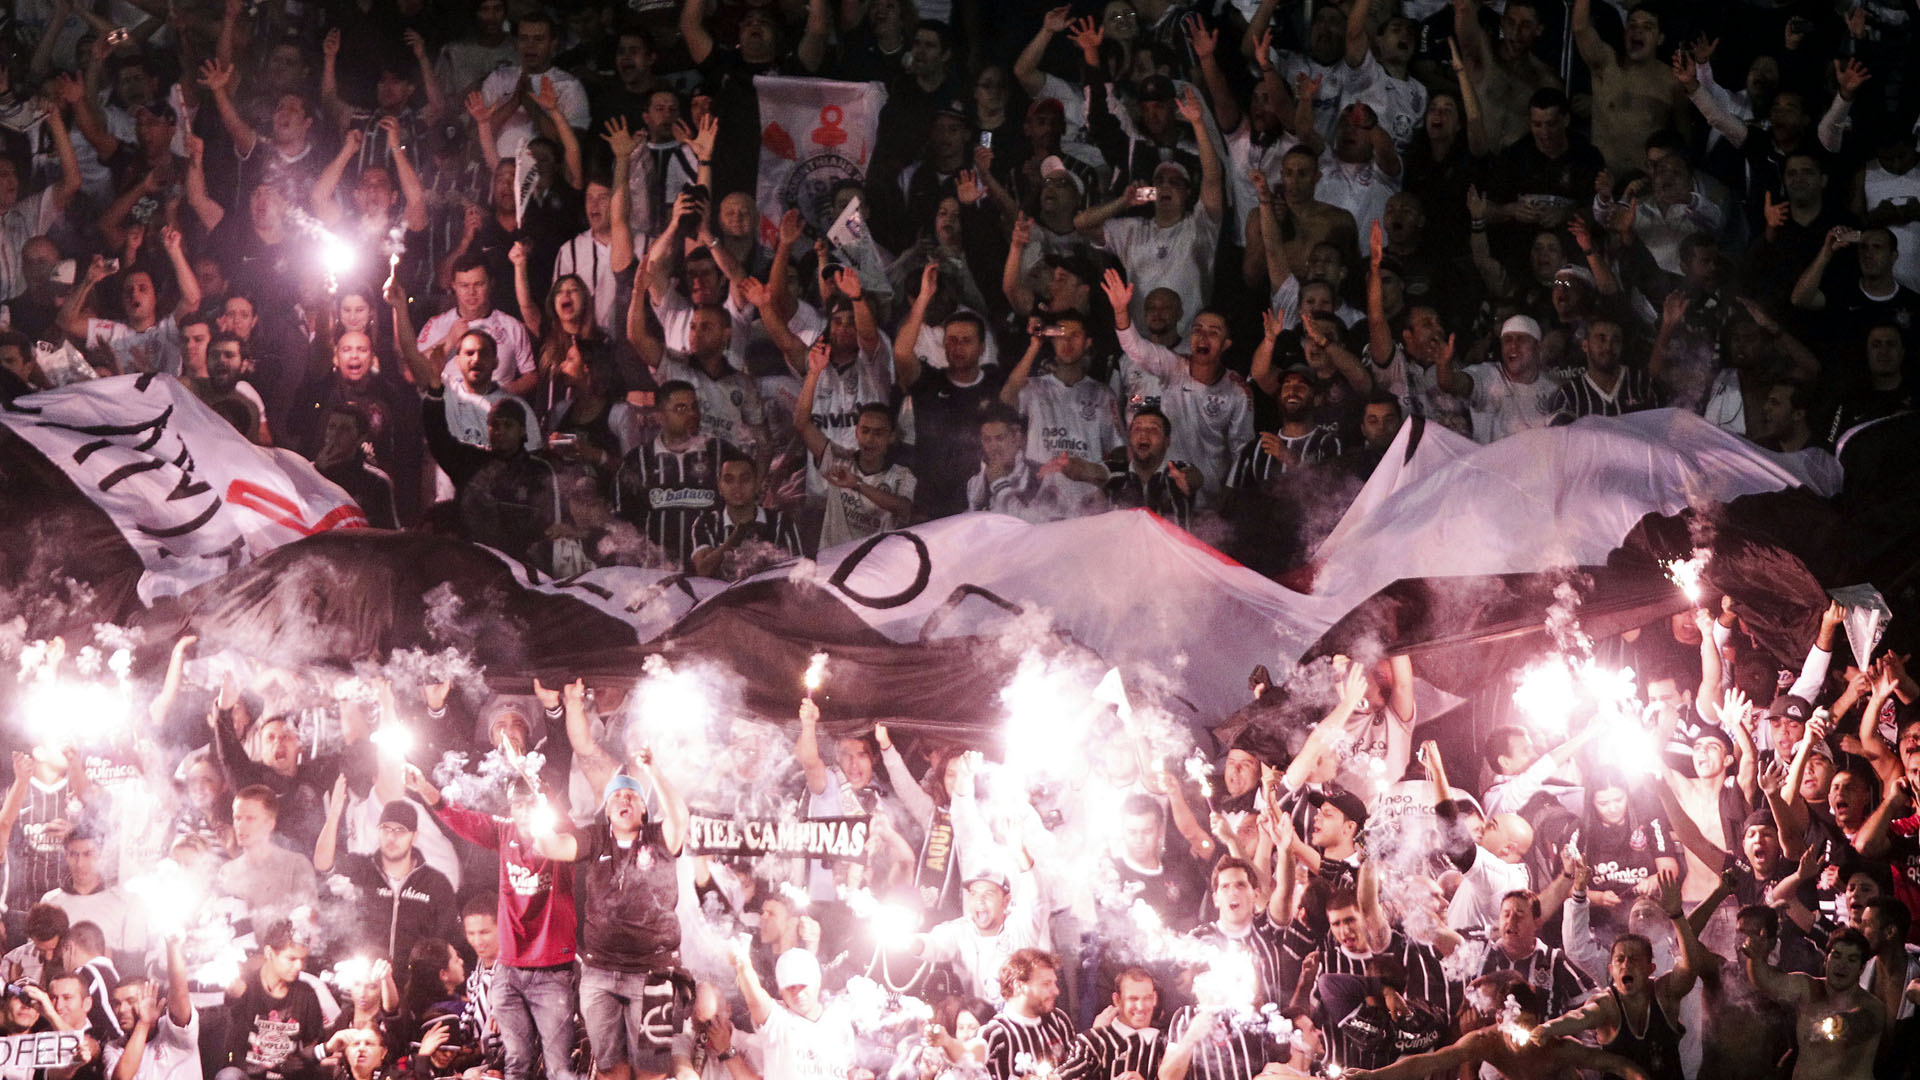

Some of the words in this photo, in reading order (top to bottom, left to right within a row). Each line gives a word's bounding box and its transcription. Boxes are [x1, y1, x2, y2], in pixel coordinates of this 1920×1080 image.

[1042, 427, 1067, 437] neo
[1384, 794, 1413, 806] neo
[690, 815, 742, 848] FIEL
[744, 821, 867, 857] CAMPINAS
